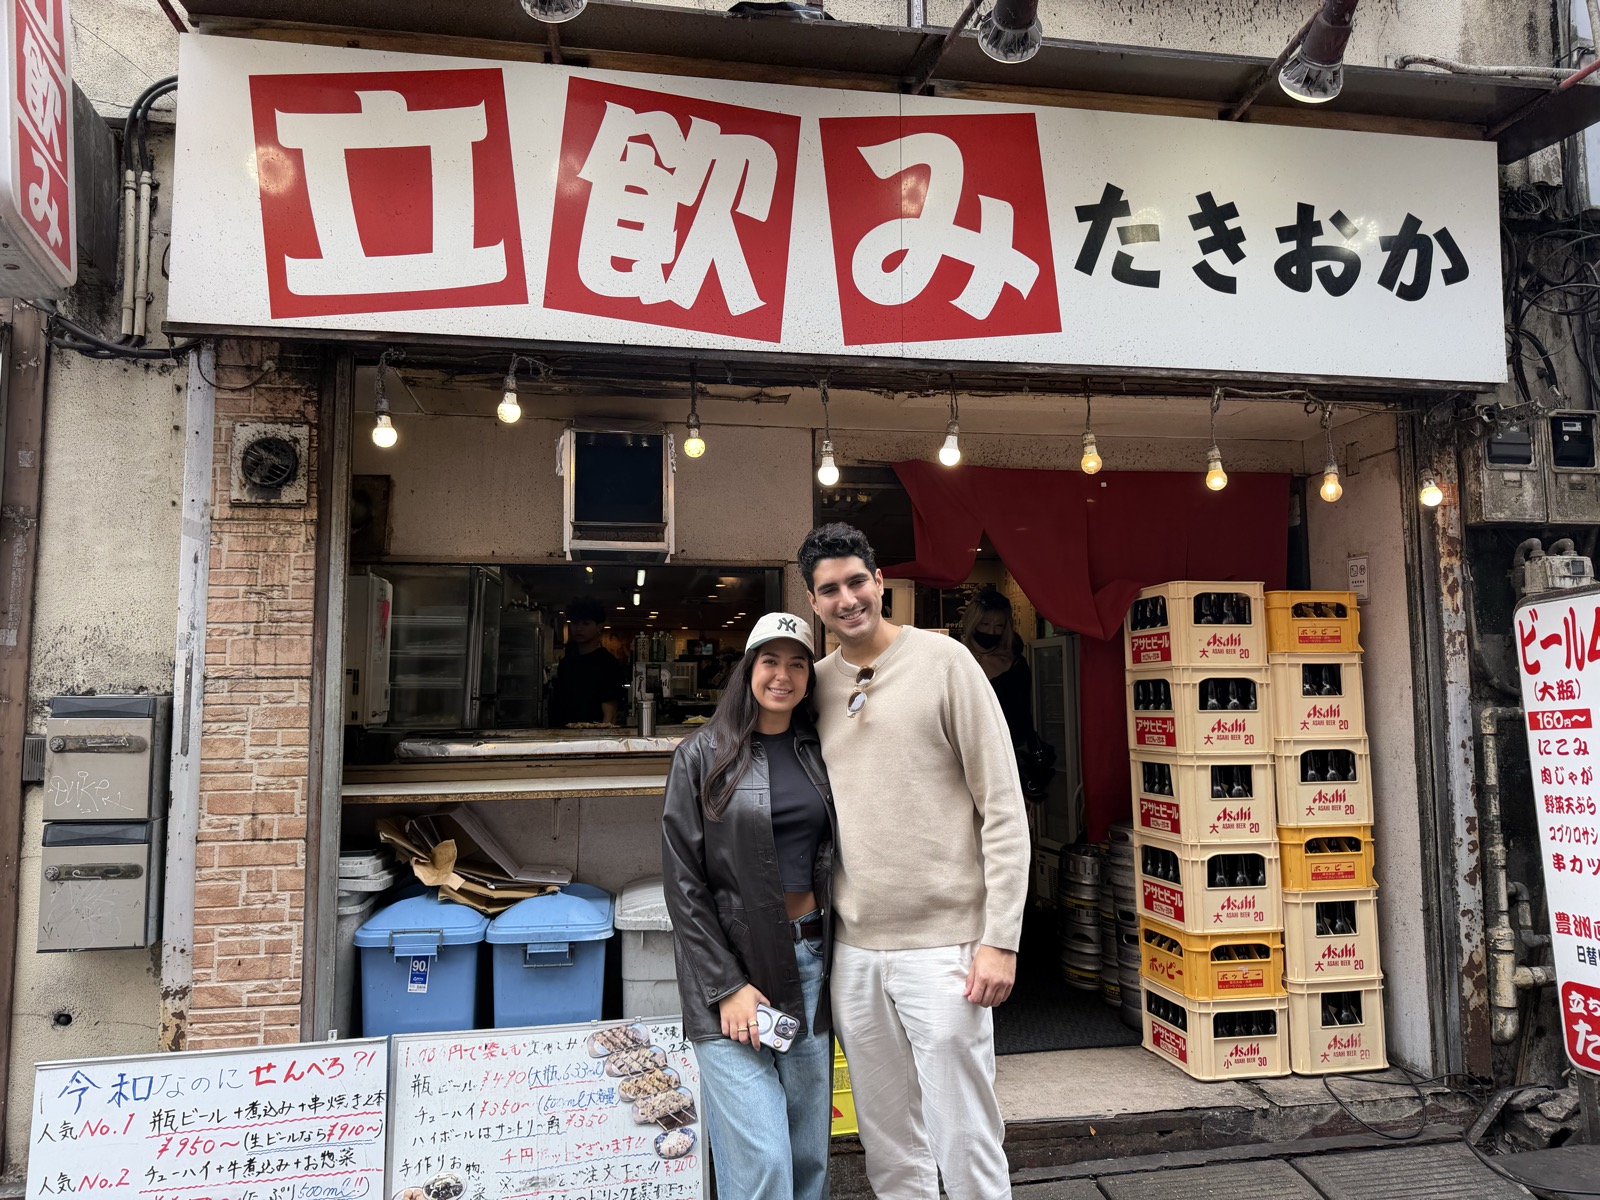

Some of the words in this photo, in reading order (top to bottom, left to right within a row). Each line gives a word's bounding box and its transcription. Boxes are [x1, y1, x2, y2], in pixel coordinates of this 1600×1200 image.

[275, 90, 1040, 320] 立飲み
[1074, 183, 1470, 302] たきおか
[777, 617, 798, 634] NY
[1131, 635, 1170, 651] アサヒビール
[1206, 633, 1242, 647] Asahi
[1239, 648, 1250, 659] 20
[1534, 678, 1581, 702] (大瓶)
[1307, 704, 1340, 719] Asahi
[1136, 719, 1174, 734] アサヒビール
[1211, 718, 1246, 733] Asahi
[1338, 720, 1349, 730] 20
[1244, 734, 1255, 745] 20
[1538, 738, 1589, 756] にこみ
[1541, 766, 1593, 785] 肉じゃが
[1312, 788, 1346, 804] Asahi
[1141, 800, 1179, 820] アサヒビール
[1344, 805, 1355, 815] 20
[1544, 794, 1597, 816] 野菜天ぷら
[1216, 806, 1251, 821] Asahi
[1249, 823, 1260, 833] 20
[1551, 852, 1600, 876] 串カツ
[1143, 882, 1183, 908] アサヒビール
[1220, 895, 1256, 911] Asahi
[1253, 911, 1264, 922] 20
[1321, 943, 1356, 959] Asahi
[1576, 945, 1600, 966] 日替
[1149, 956, 1184, 981] ホッピー
[1354, 960, 1364, 970] 20
[1152, 1023, 1186, 1051] アサヒビール
[1327, 1033, 1362, 1050] Asahi
[1229, 1043, 1260, 1057] Asahi
[1257, 1057, 1267, 1067] 30
[37, 1113, 136, 1144] 人気No.1
[38, 1168, 130, 1196] 人気No.2
